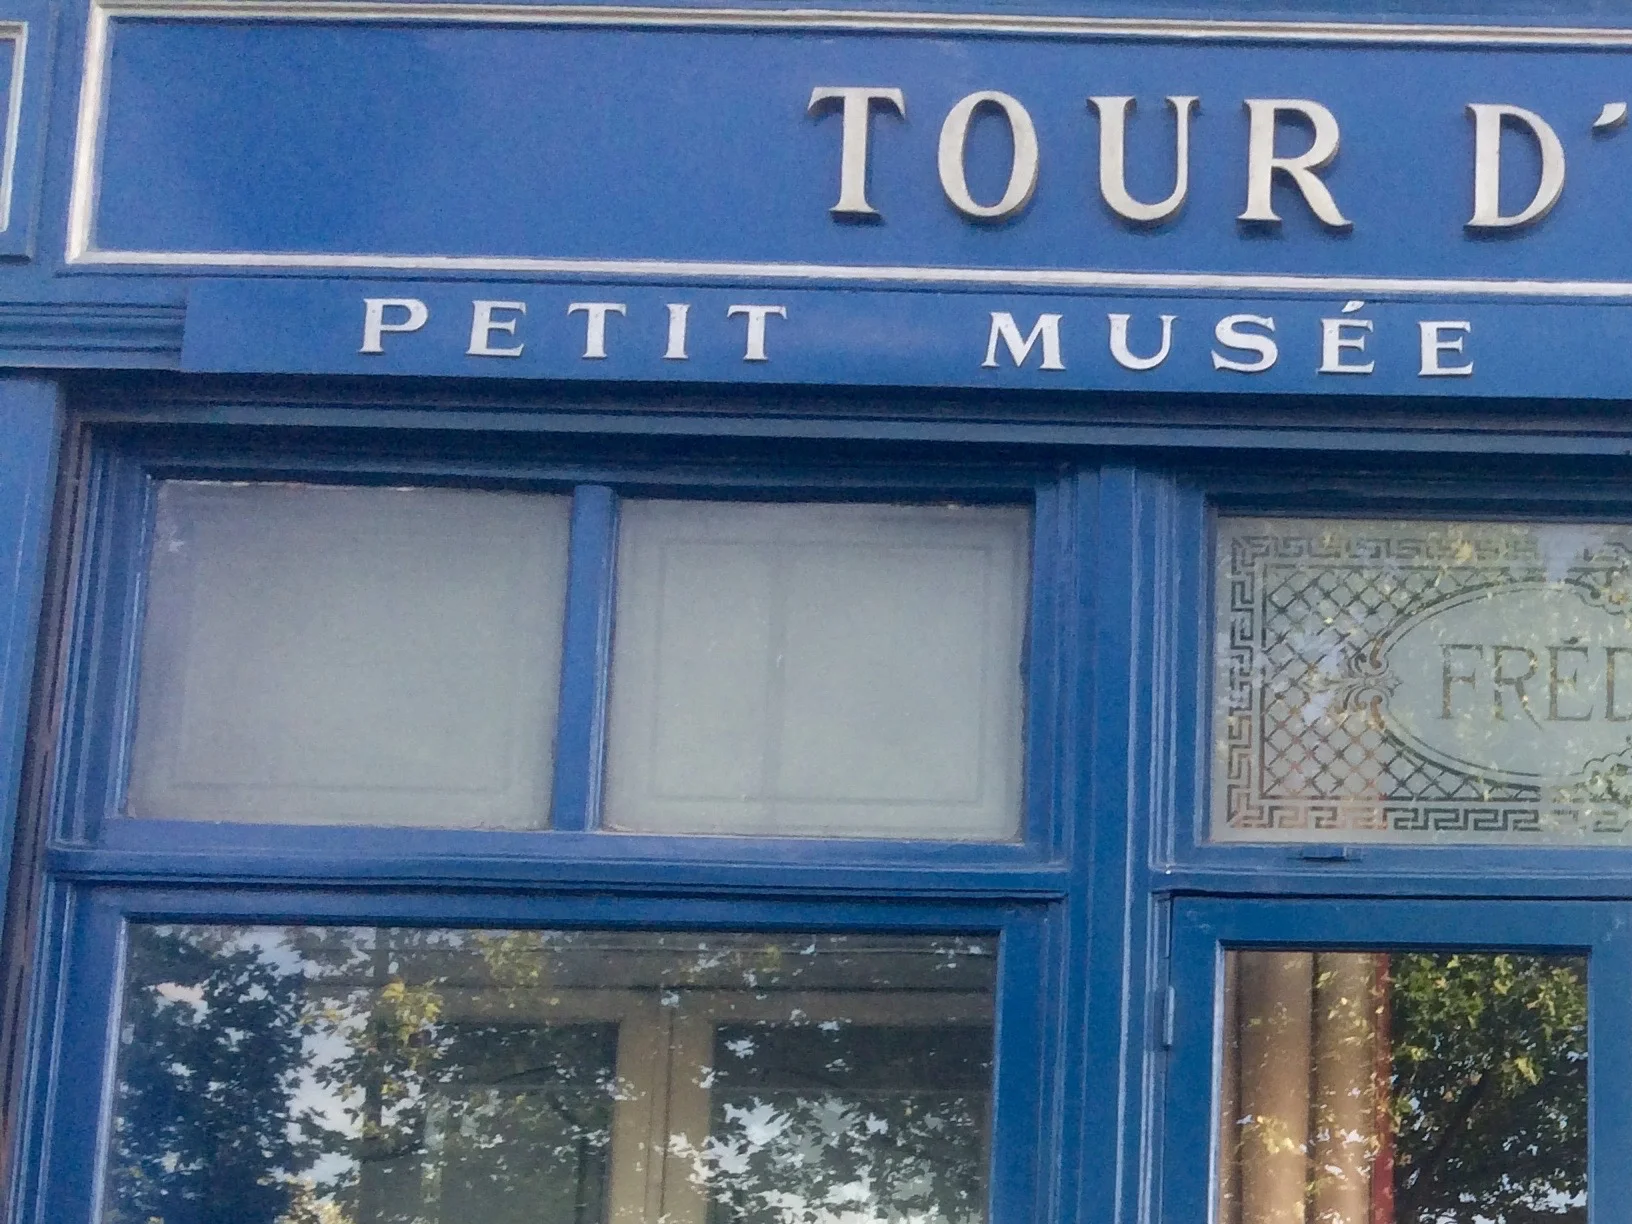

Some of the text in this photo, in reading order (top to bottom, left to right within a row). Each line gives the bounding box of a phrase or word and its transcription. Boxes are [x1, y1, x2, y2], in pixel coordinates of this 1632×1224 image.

[808, 86, 1353, 232] TOUR
[360, 297, 788, 361] PETIT
[981, 301, 1475, 376] MUSÉE
